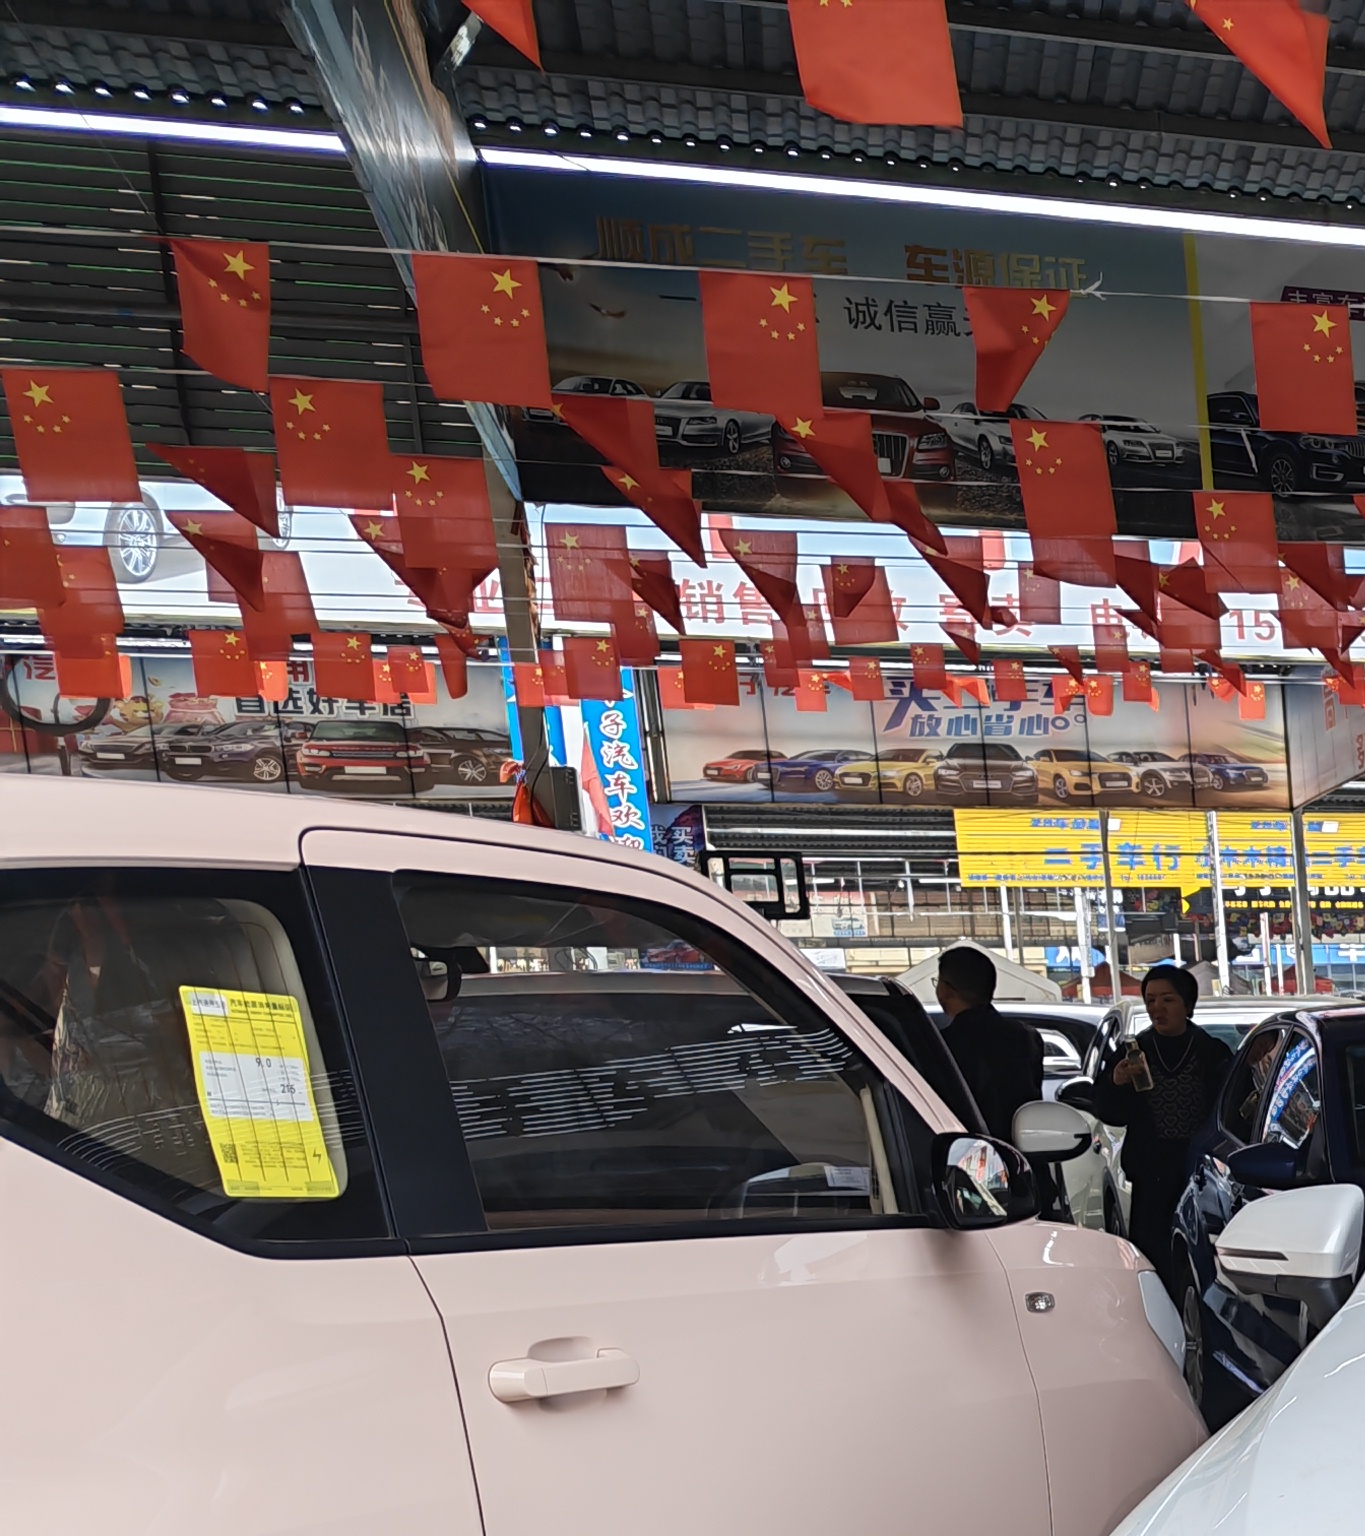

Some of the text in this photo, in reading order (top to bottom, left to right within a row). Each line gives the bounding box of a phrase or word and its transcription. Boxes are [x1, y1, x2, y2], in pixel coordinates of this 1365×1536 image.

[596, 217, 1087, 289] 顺成二手车 车源保证
[843, 296, 973, 337] 诚信赢
